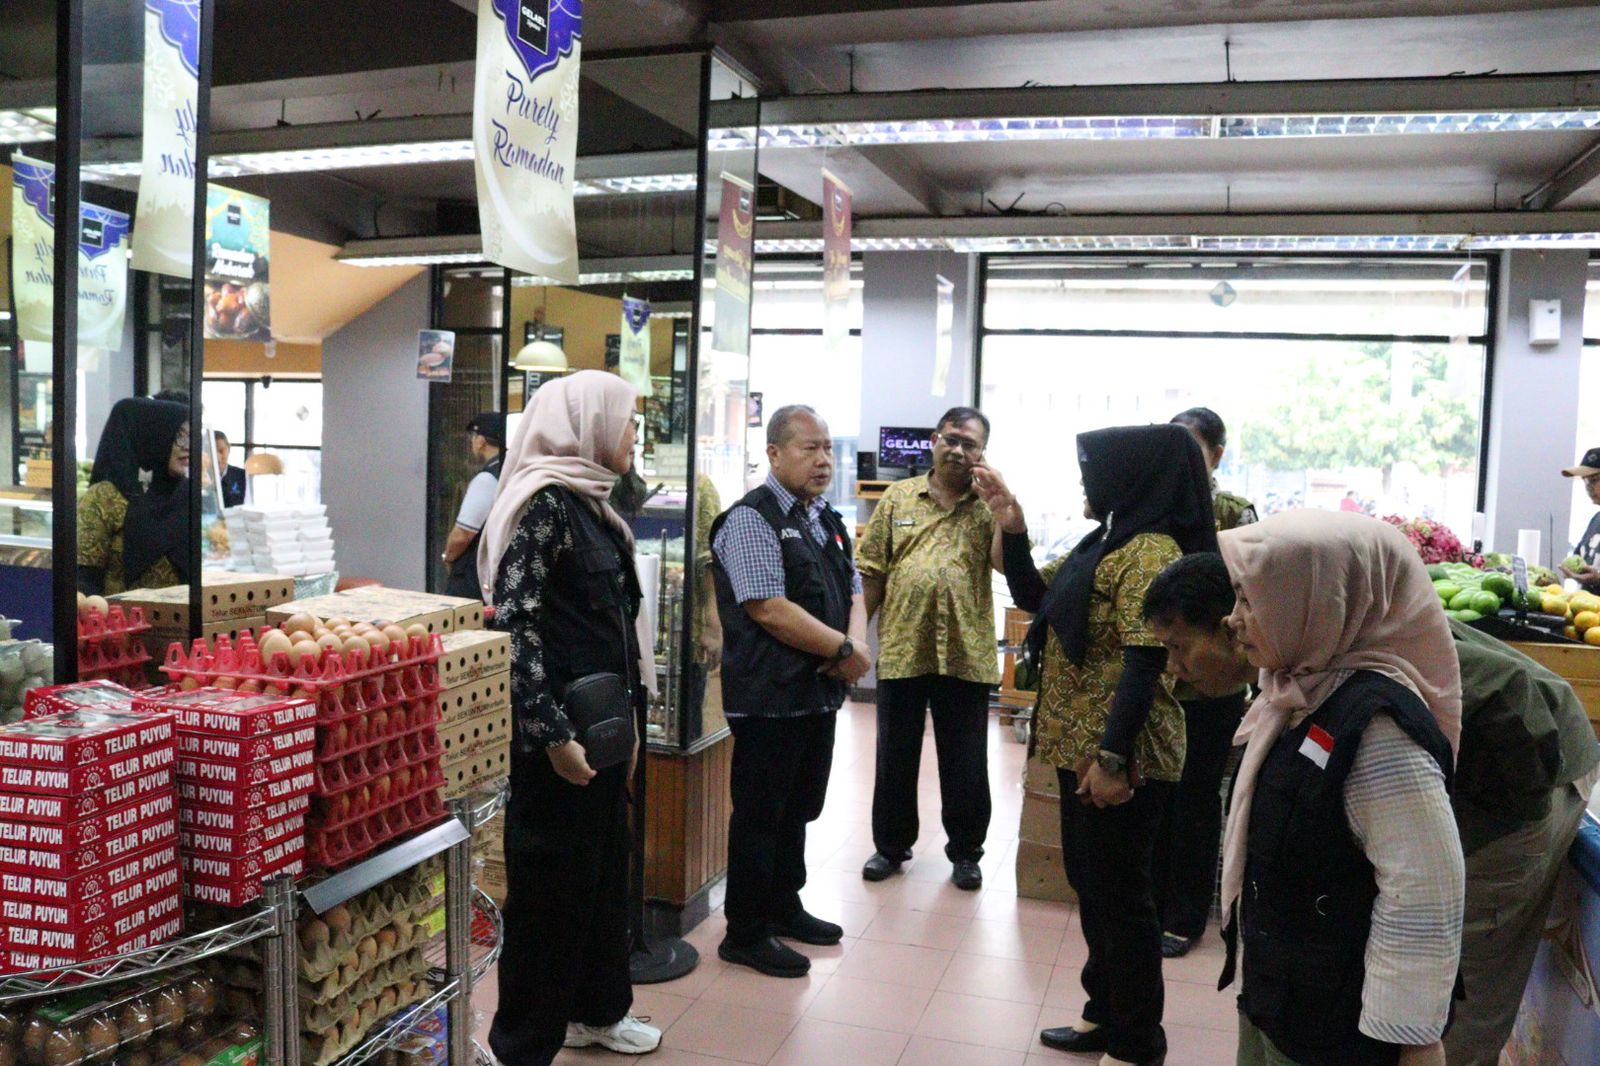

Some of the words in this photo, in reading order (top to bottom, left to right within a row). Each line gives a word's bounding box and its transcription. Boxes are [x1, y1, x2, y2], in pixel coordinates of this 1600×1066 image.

[505, 69, 560, 145] Purely
[492, 118, 565, 185] Ramadan
[204, 713, 240, 731] PUYUH
[273, 707, 294, 725] TELUR
[295, 703, 316, 720] PUYUH
[104, 733, 136, 755] TELUR
[140, 723, 172, 745] PUYUH
[178, 736, 200, 753] LUR
[203, 739, 240, 757] PUYUH
[272, 732, 293, 751] TELUR
[31, 744, 64, 762] PUYUH
[109, 757, 139, 780] TELUR
[143, 747, 174, 770] PUYUH
[176, 761, 197, 777] LUR
[200, 764, 236, 782] PUYUH
[270, 756, 292, 774] TELUR
[2, 768, 32, 786] TELUR
[34, 771, 69, 789] PUYUH
[104, 783, 135, 805] TELUR
[139, 769, 170, 792] PUYUH
[268, 779, 291, 798] TELUR
[199, 787, 234, 805] PUYUH
[0, 797, 24, 813] ELUR
[27, 799, 61, 817] PUYUH
[106, 808, 137, 831] TELUR
[140, 795, 172, 819] PUYUH
[197, 811, 234, 829] PUYUH
[29, 826, 63, 845] PUYUH
[106, 833, 138, 857] TELUR
[142, 819, 174, 845] PUYUH
[194, 834, 232, 852] PUYUH
[29, 849, 60, 870] PUYUH
[108, 861, 139, 886] TELUR
[143, 847, 174, 872] PUYUH
[193, 858, 230, 877] PUYUH
[2, 875, 31, 893] TELUR
[34, 878, 67, 898] PUYUH
[111, 883, 142, 909] TELUR
[146, 868, 178, 893] PUYUH
[194, 884, 231, 903] PUYUH
[3, 901, 32, 919] TELUR
[35, 906, 68, 924] PUYUH
[114, 910, 145, 936] TELUR
[148, 894, 178, 921] PUYUH
[8, 926, 38, 945] TELUR
[41, 931, 75, 950] PUYUH
[150, 918, 180, 944] PUYUH
[10, 951, 40, 968] TELUR
